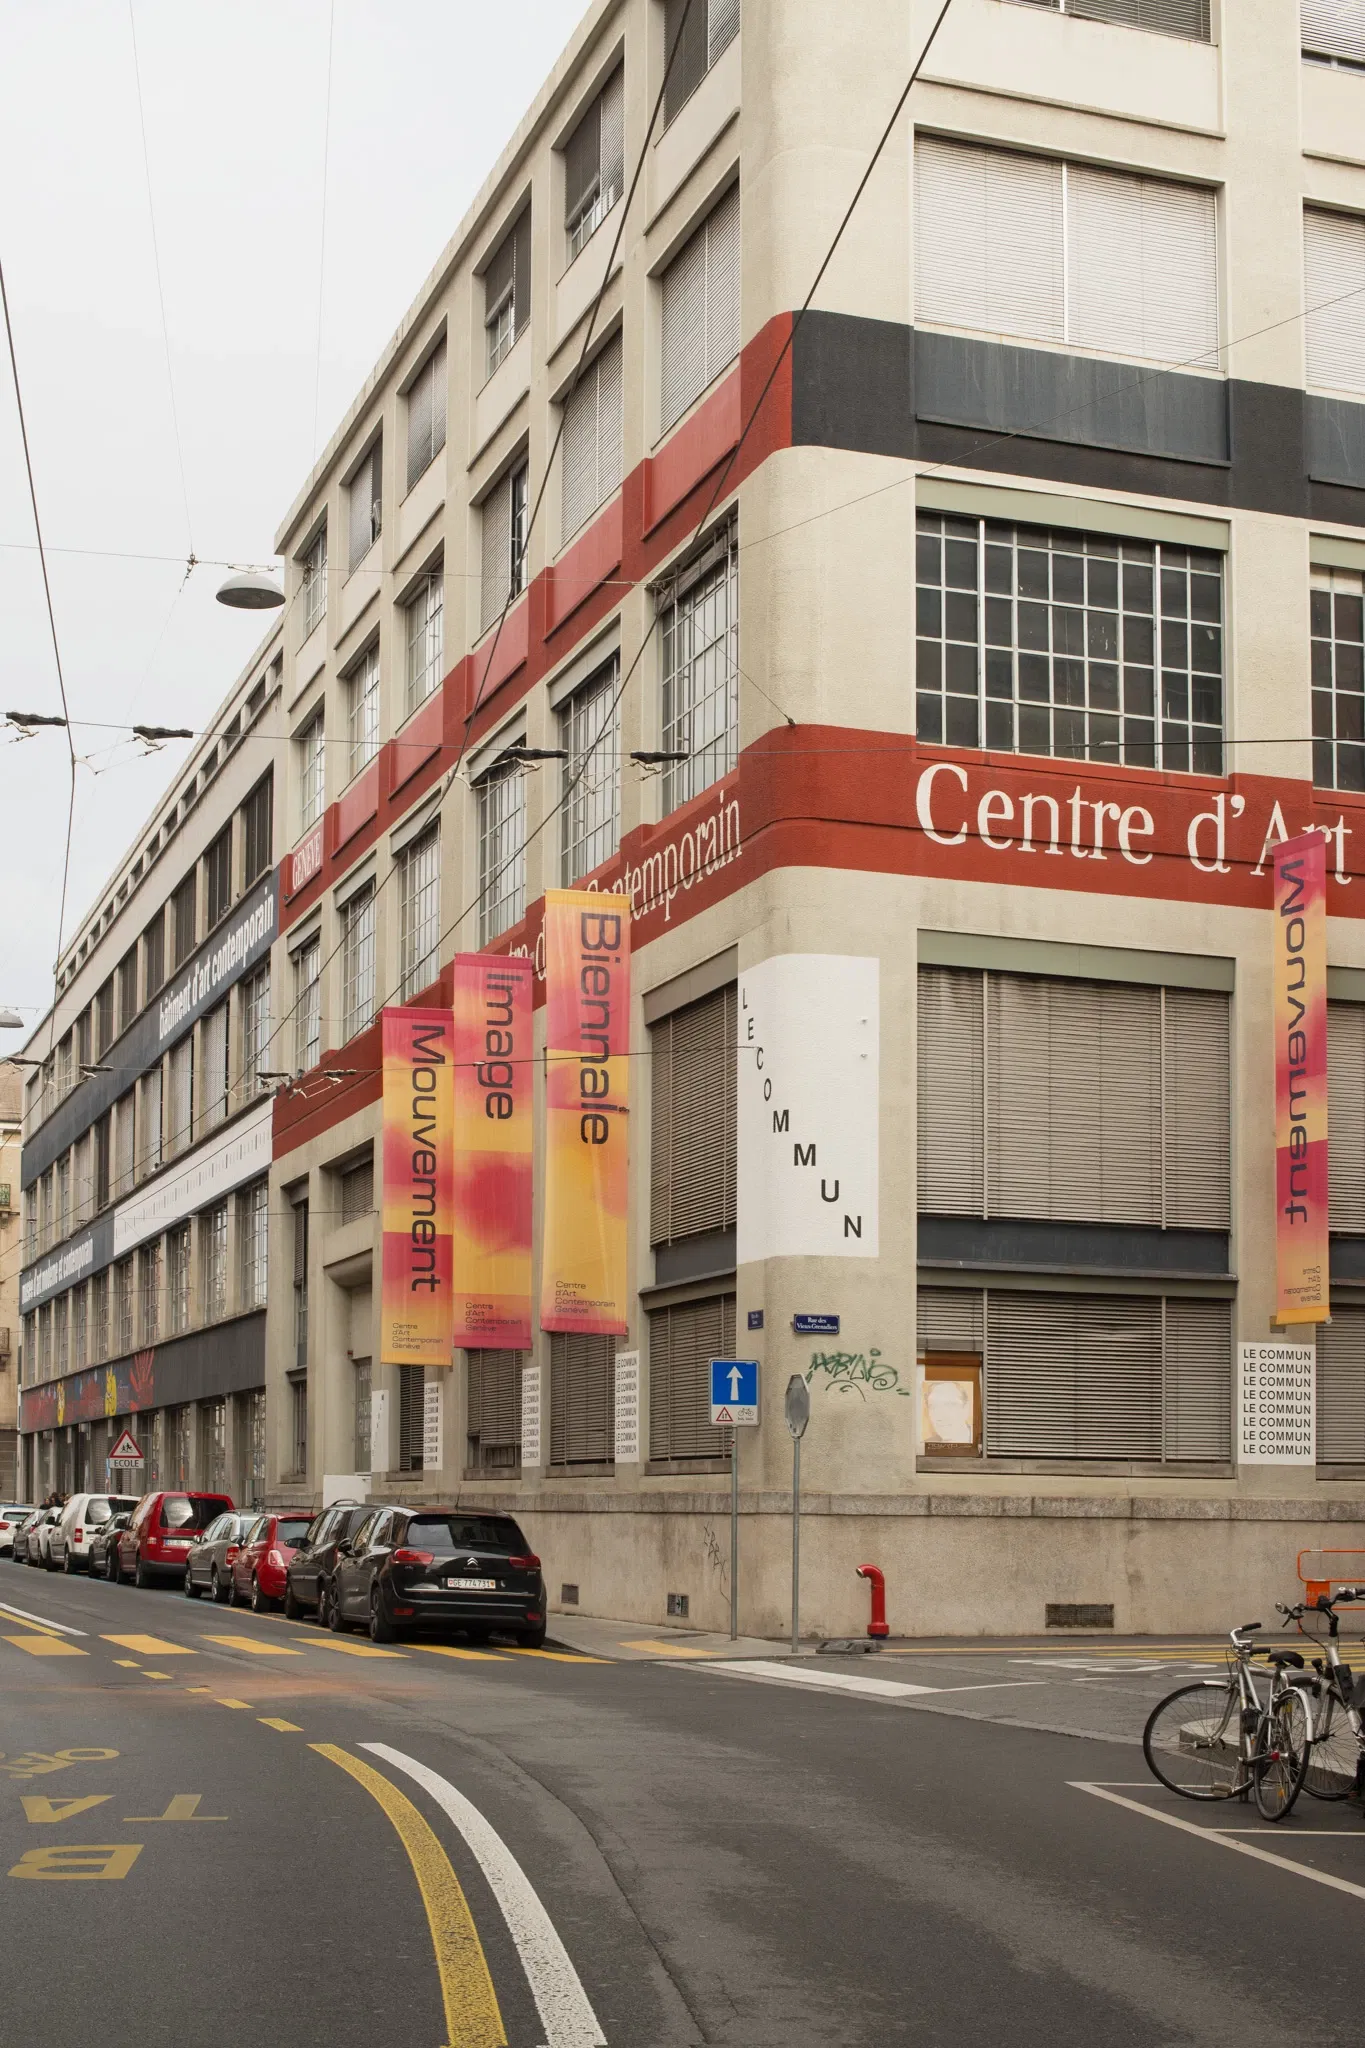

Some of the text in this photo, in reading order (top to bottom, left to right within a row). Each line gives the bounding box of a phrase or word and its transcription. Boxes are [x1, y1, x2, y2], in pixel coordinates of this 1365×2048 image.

[915, 763, 1155, 865] Centre
[192, 959, 211, 1006] d'art
[212, 886, 275, 987] contemporain
[579, 911, 622, 1146] Biennale
[476, 971, 524, 1121] Image
[411, 1023, 446, 1293] Mouvement
[555, 1280, 587, 1289] Centre
[555, 1289, 577, 1297] d'Art
[465, 1302, 494, 1310] Centre
[555, 1297, 616, 1307] Contemporain
[392, 1322, 418, 1330] Centre
[465, 1316, 522, 1325] Contemporain
[392, 1336, 444, 1344] Contemporain
[1243, 1349, 1311, 1360] LE COMMUN
[1243, 1362, 1311, 1374] LE COMMUN
[1243, 1376, 1311, 1388] LE COMMUN
[1243, 1389, 1311, 1401] LE COMMUN
[1243, 1403, 1311, 1415] LE COMMUN
[1243, 1417, 1311, 1428] LE COMMUN
[1243, 1430, 1311, 1442] LE COMMUN
[1243, 1444, 1311, 1455] LE COMMUN
[113, 1459, 140, 1468] ECOLE
